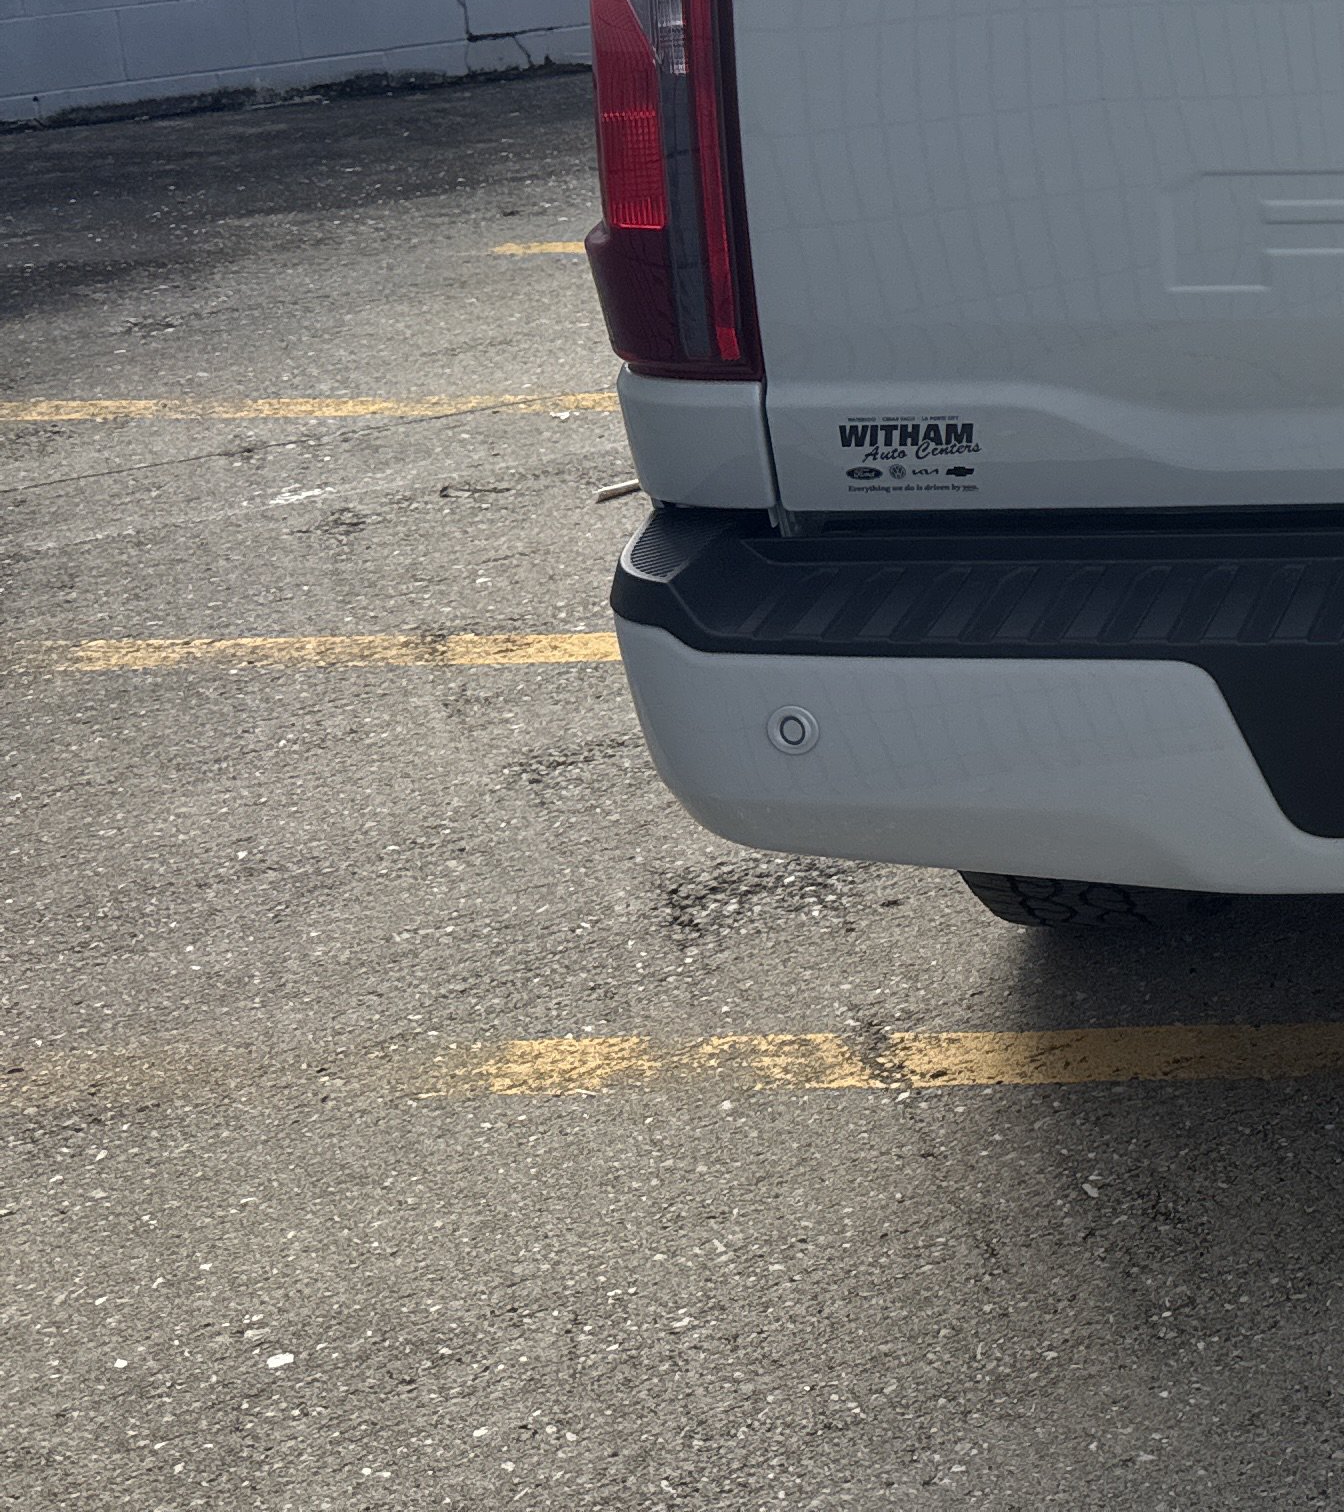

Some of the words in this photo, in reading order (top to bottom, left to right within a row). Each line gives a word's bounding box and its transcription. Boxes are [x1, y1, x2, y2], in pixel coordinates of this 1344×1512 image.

[839, 423, 974, 447] WITHAM
[862, 445, 907, 463] Auto
[915, 439, 982, 460] Centers
